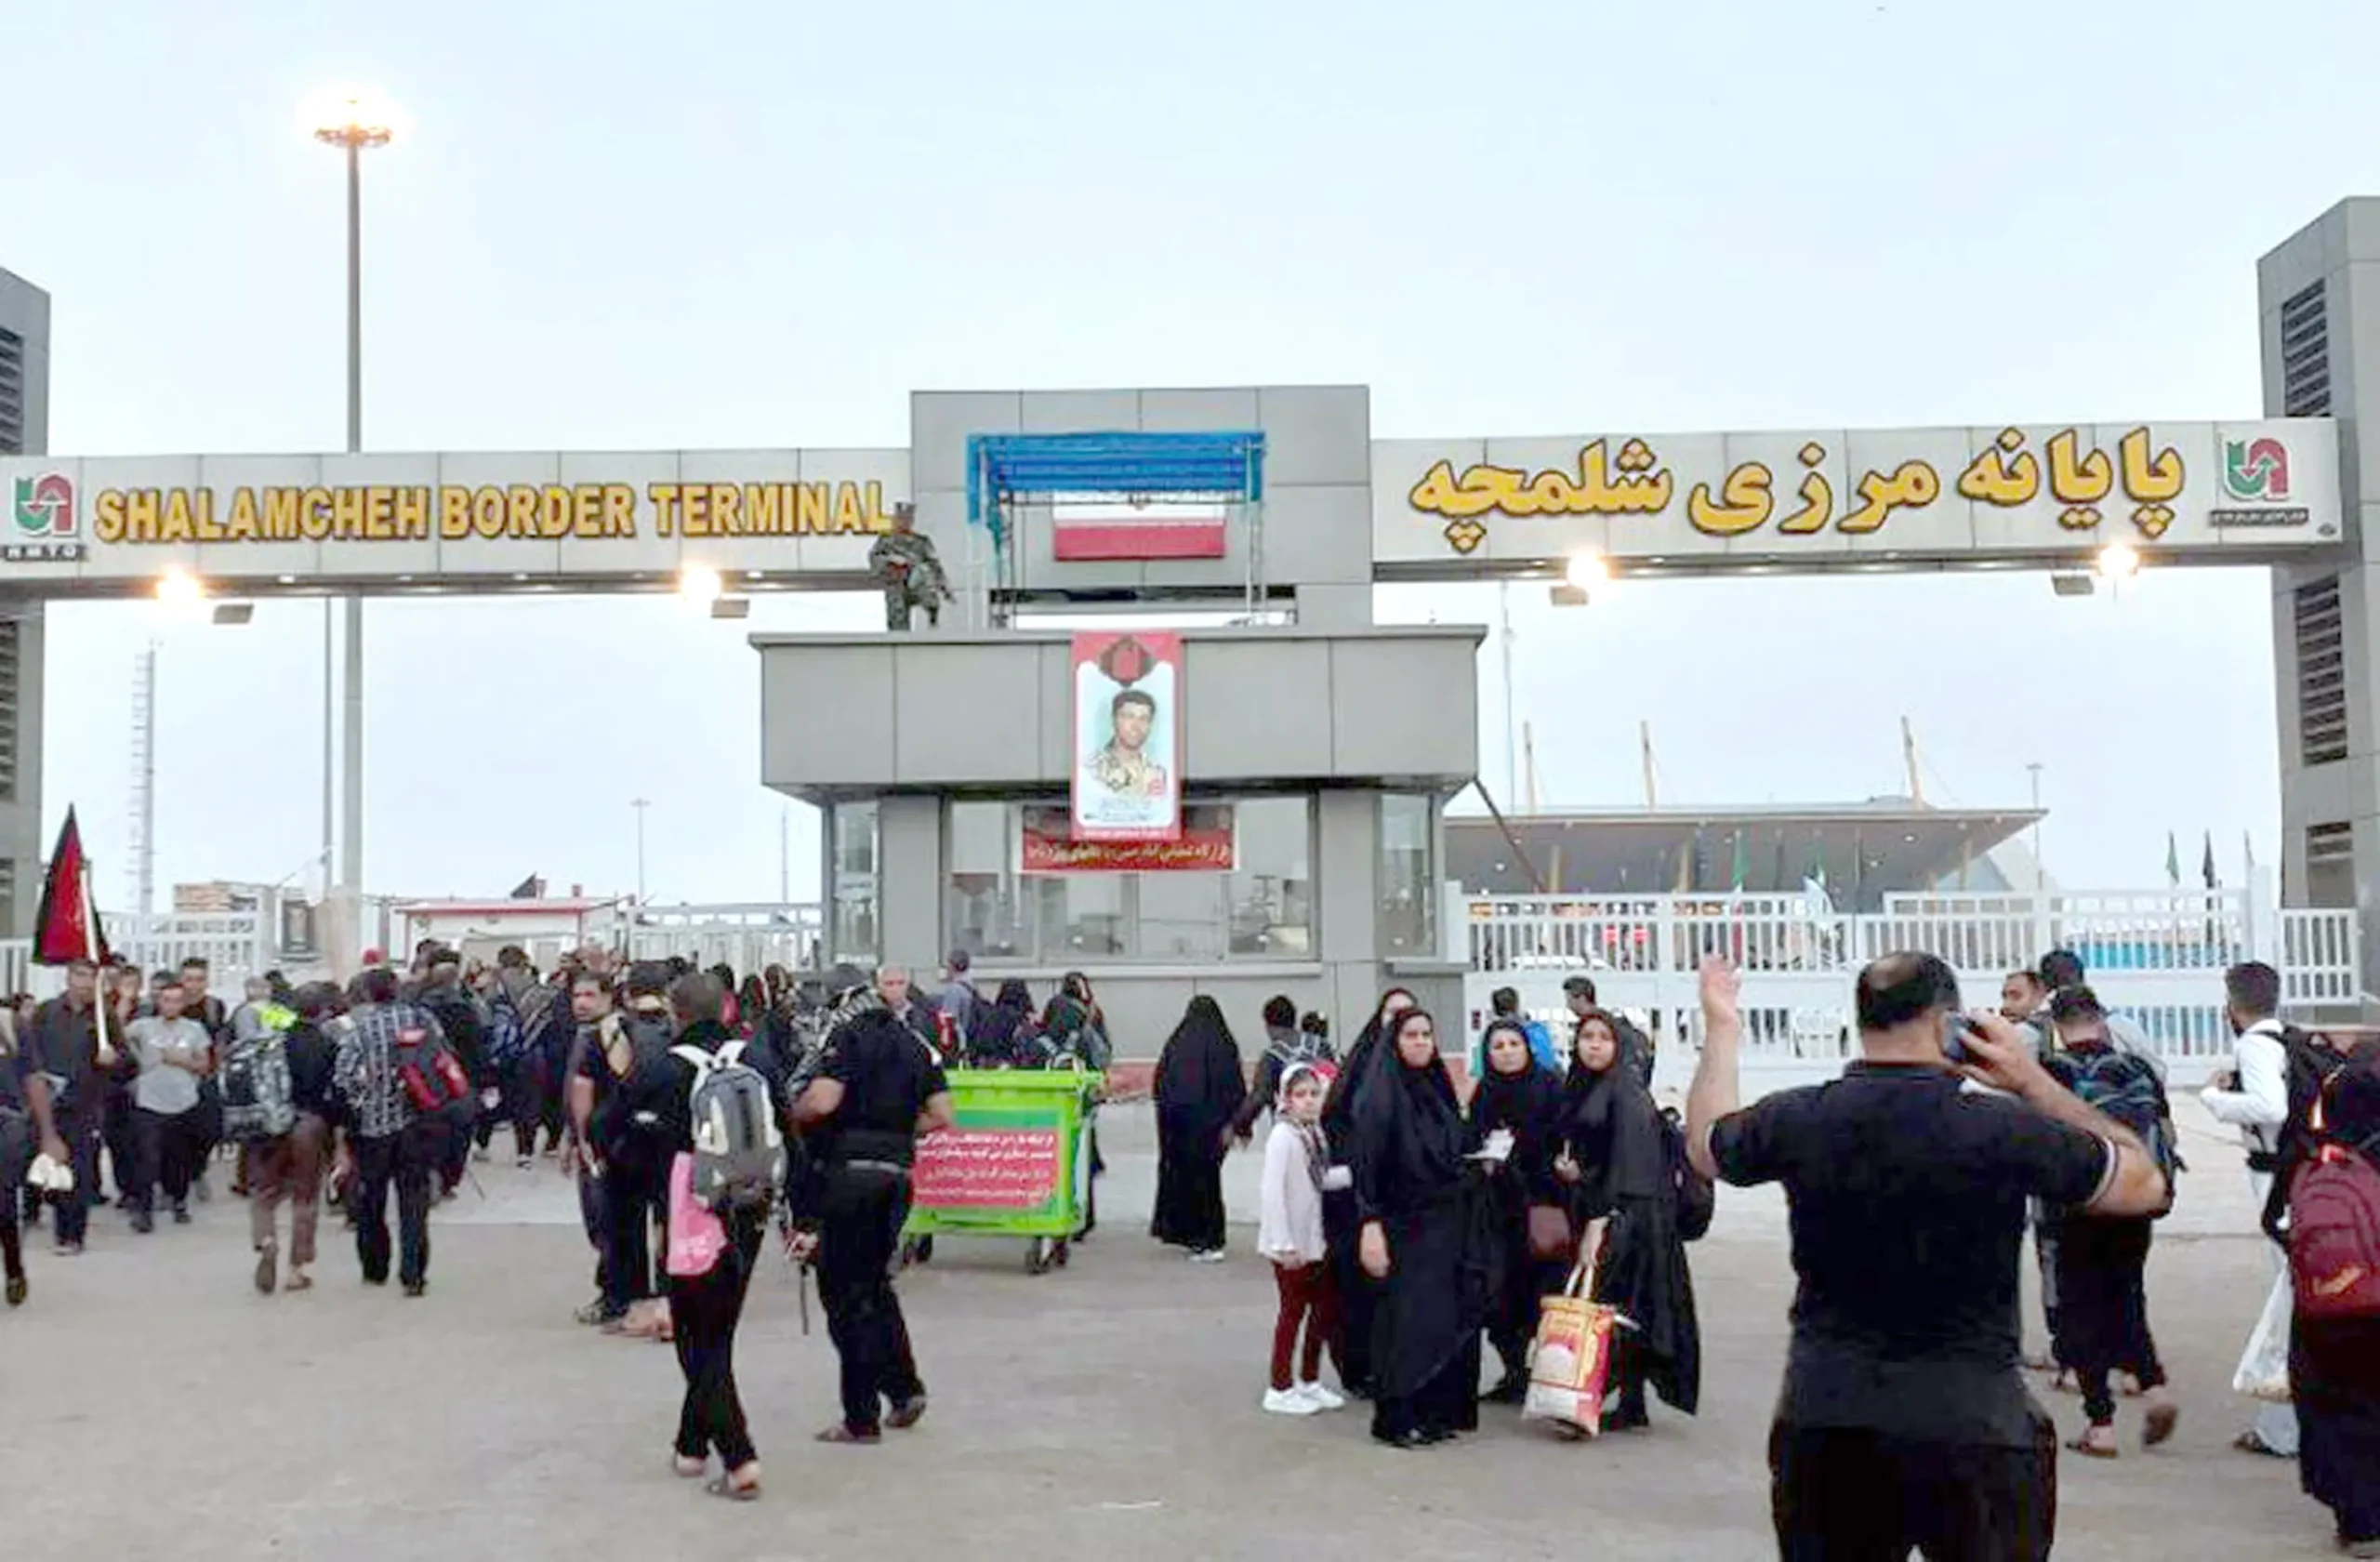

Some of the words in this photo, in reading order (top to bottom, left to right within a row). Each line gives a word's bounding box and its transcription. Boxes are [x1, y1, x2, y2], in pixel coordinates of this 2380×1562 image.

[94, 486, 430, 542] SHALAMCHEH
[441, 483, 635, 539] BORDER
[649, 480, 893, 537] TERMINAL
[1408, 437, 1673, 554] شلمچه
[1687, 441, 1940, 537] مرزی
[1957, 425, 2186, 540] پایانه
